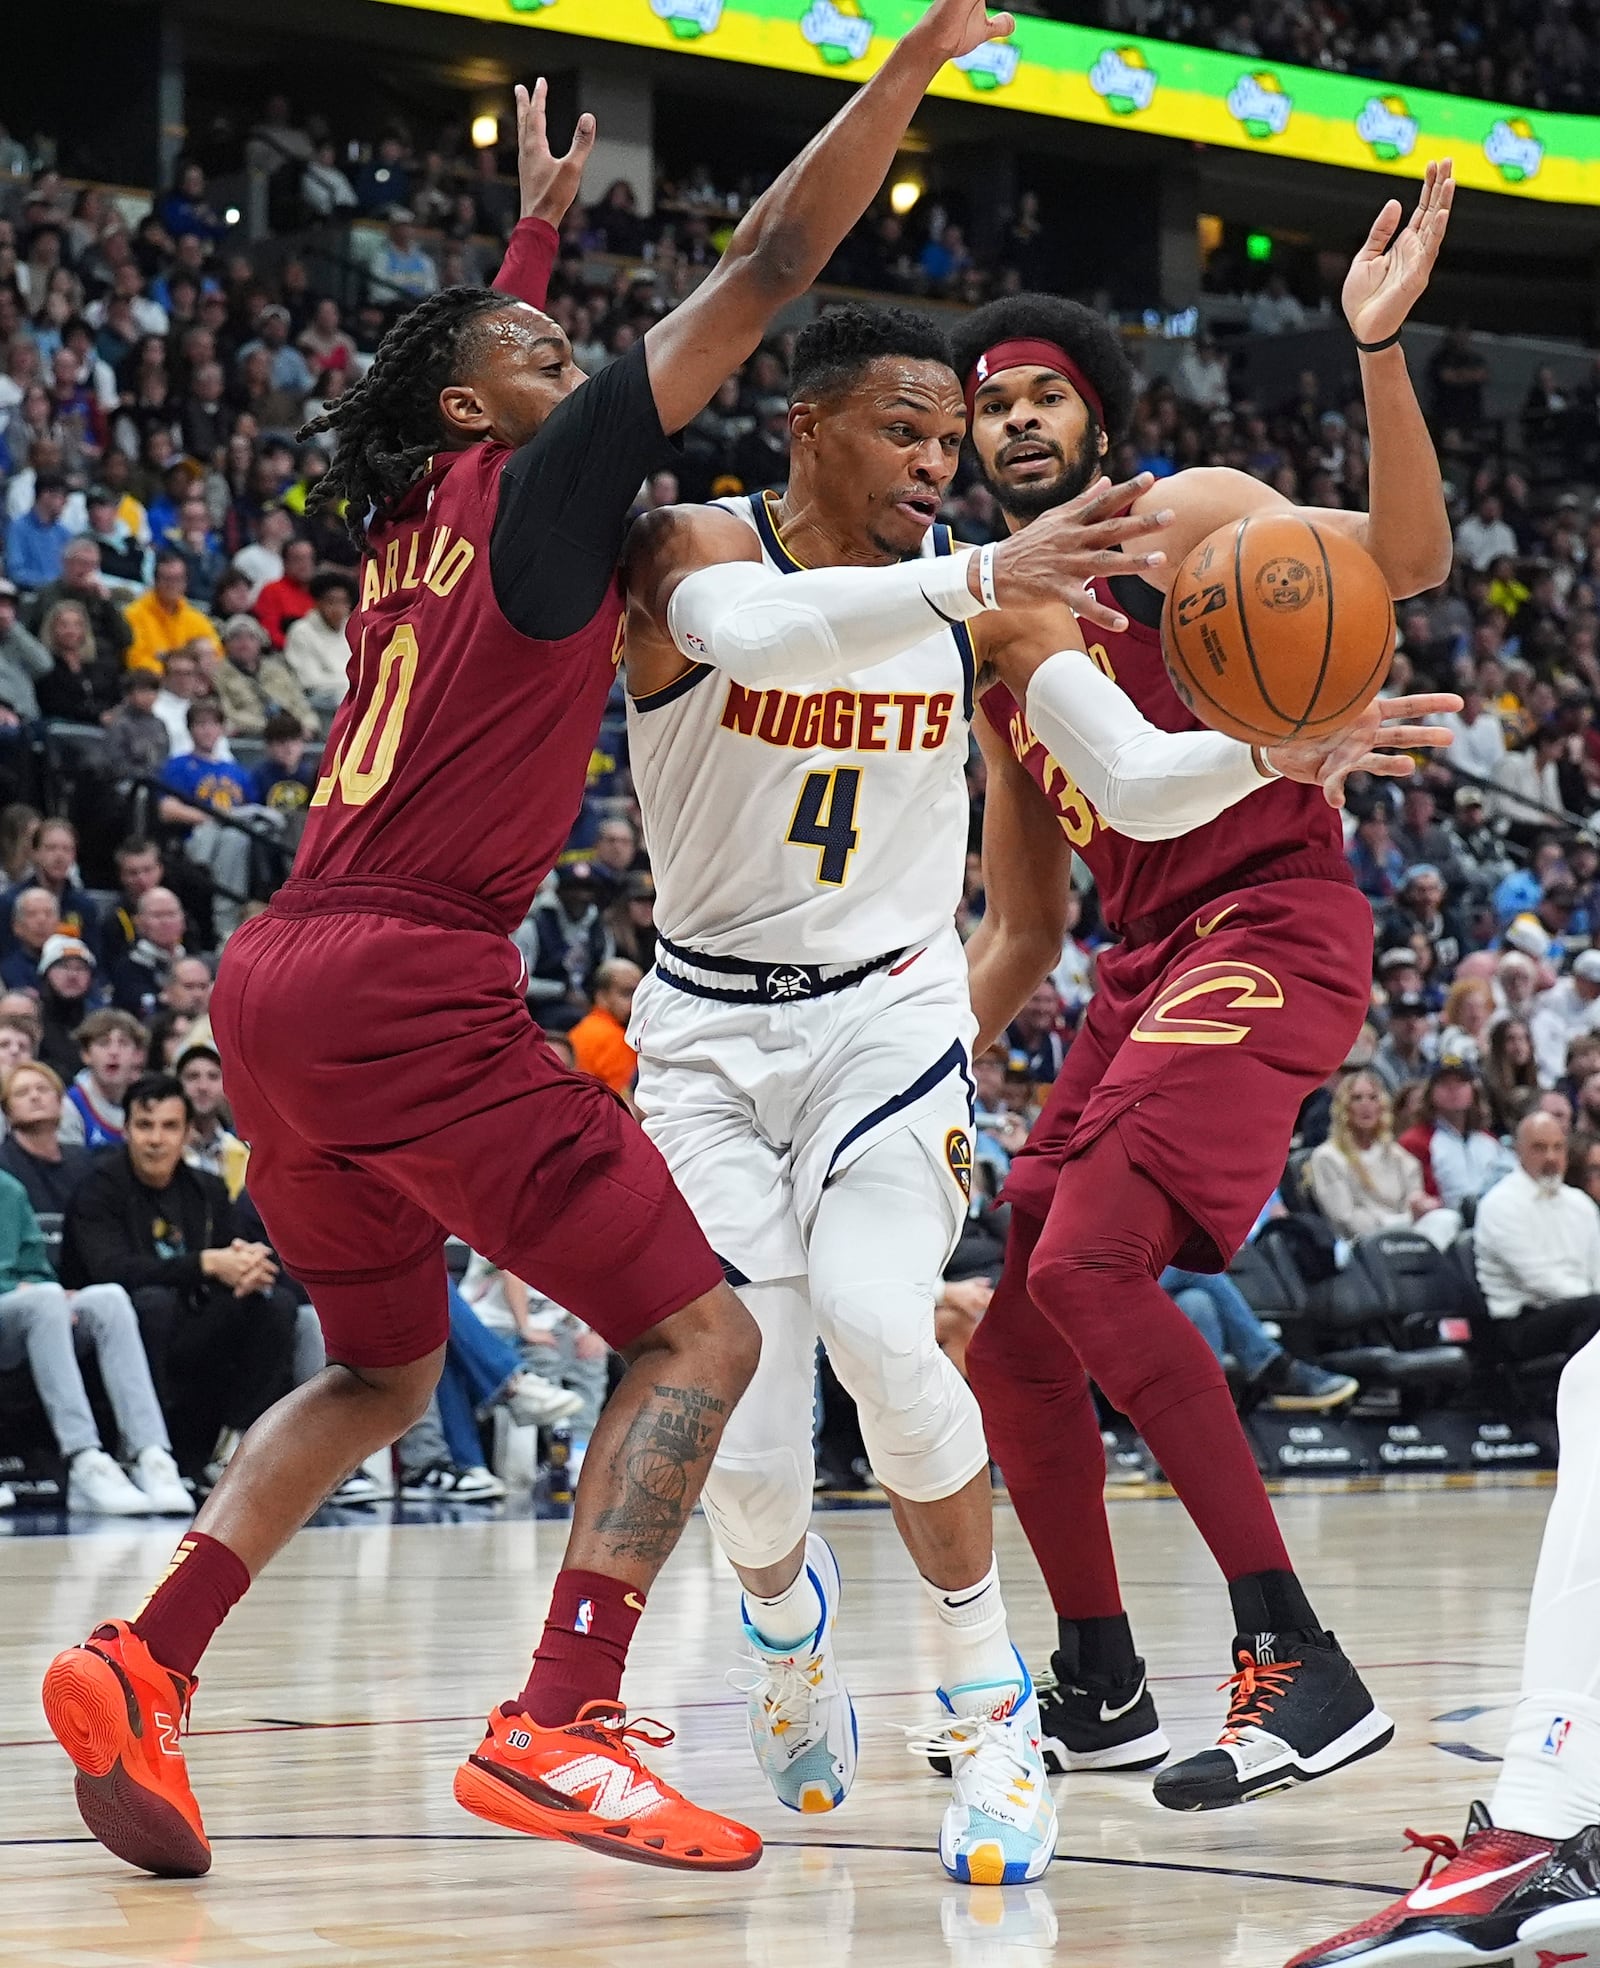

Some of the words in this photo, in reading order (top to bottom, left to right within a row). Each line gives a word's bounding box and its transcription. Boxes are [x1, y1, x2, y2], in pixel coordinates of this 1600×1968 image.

[720, 678, 955, 753] NUGGETS
[784, 765, 864, 888] 4
[1042, 752, 1111, 848] 3
[507, 1729, 531, 1750] 10
